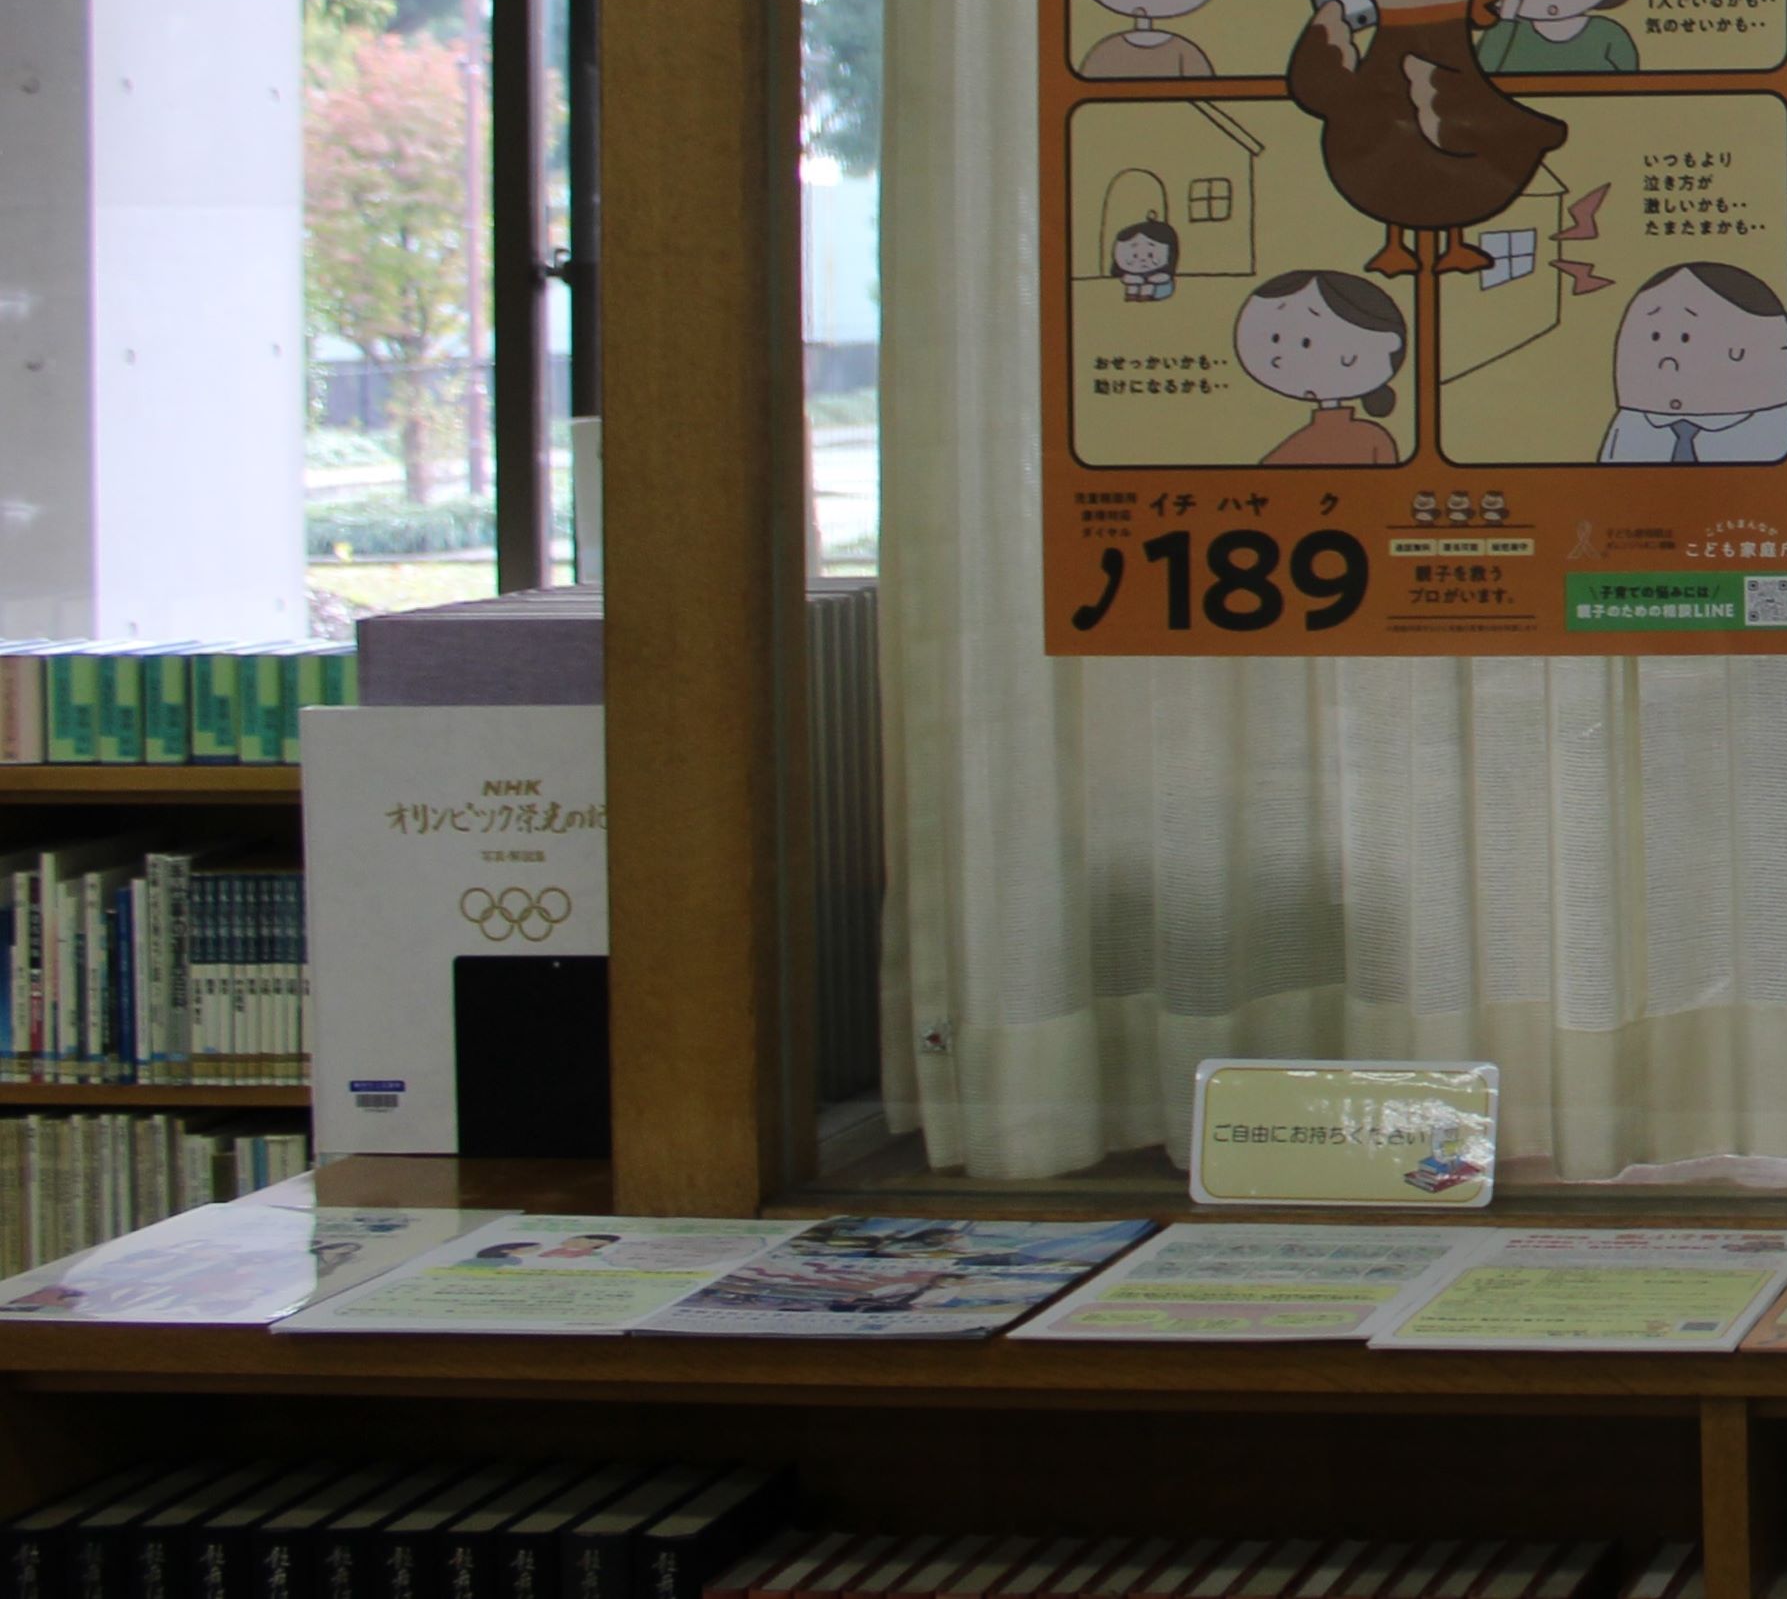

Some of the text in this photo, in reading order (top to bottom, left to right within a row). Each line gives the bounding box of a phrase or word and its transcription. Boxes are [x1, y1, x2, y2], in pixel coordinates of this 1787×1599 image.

[1643, 152, 1734, 169] いつもより
[1643, 174, 1714, 192] 泣き方が
[1151, 492, 1339, 516] イチ ハヤ ク
[1143, 528, 1369, 632] 189
[483, 779, 543, 796] NHK
